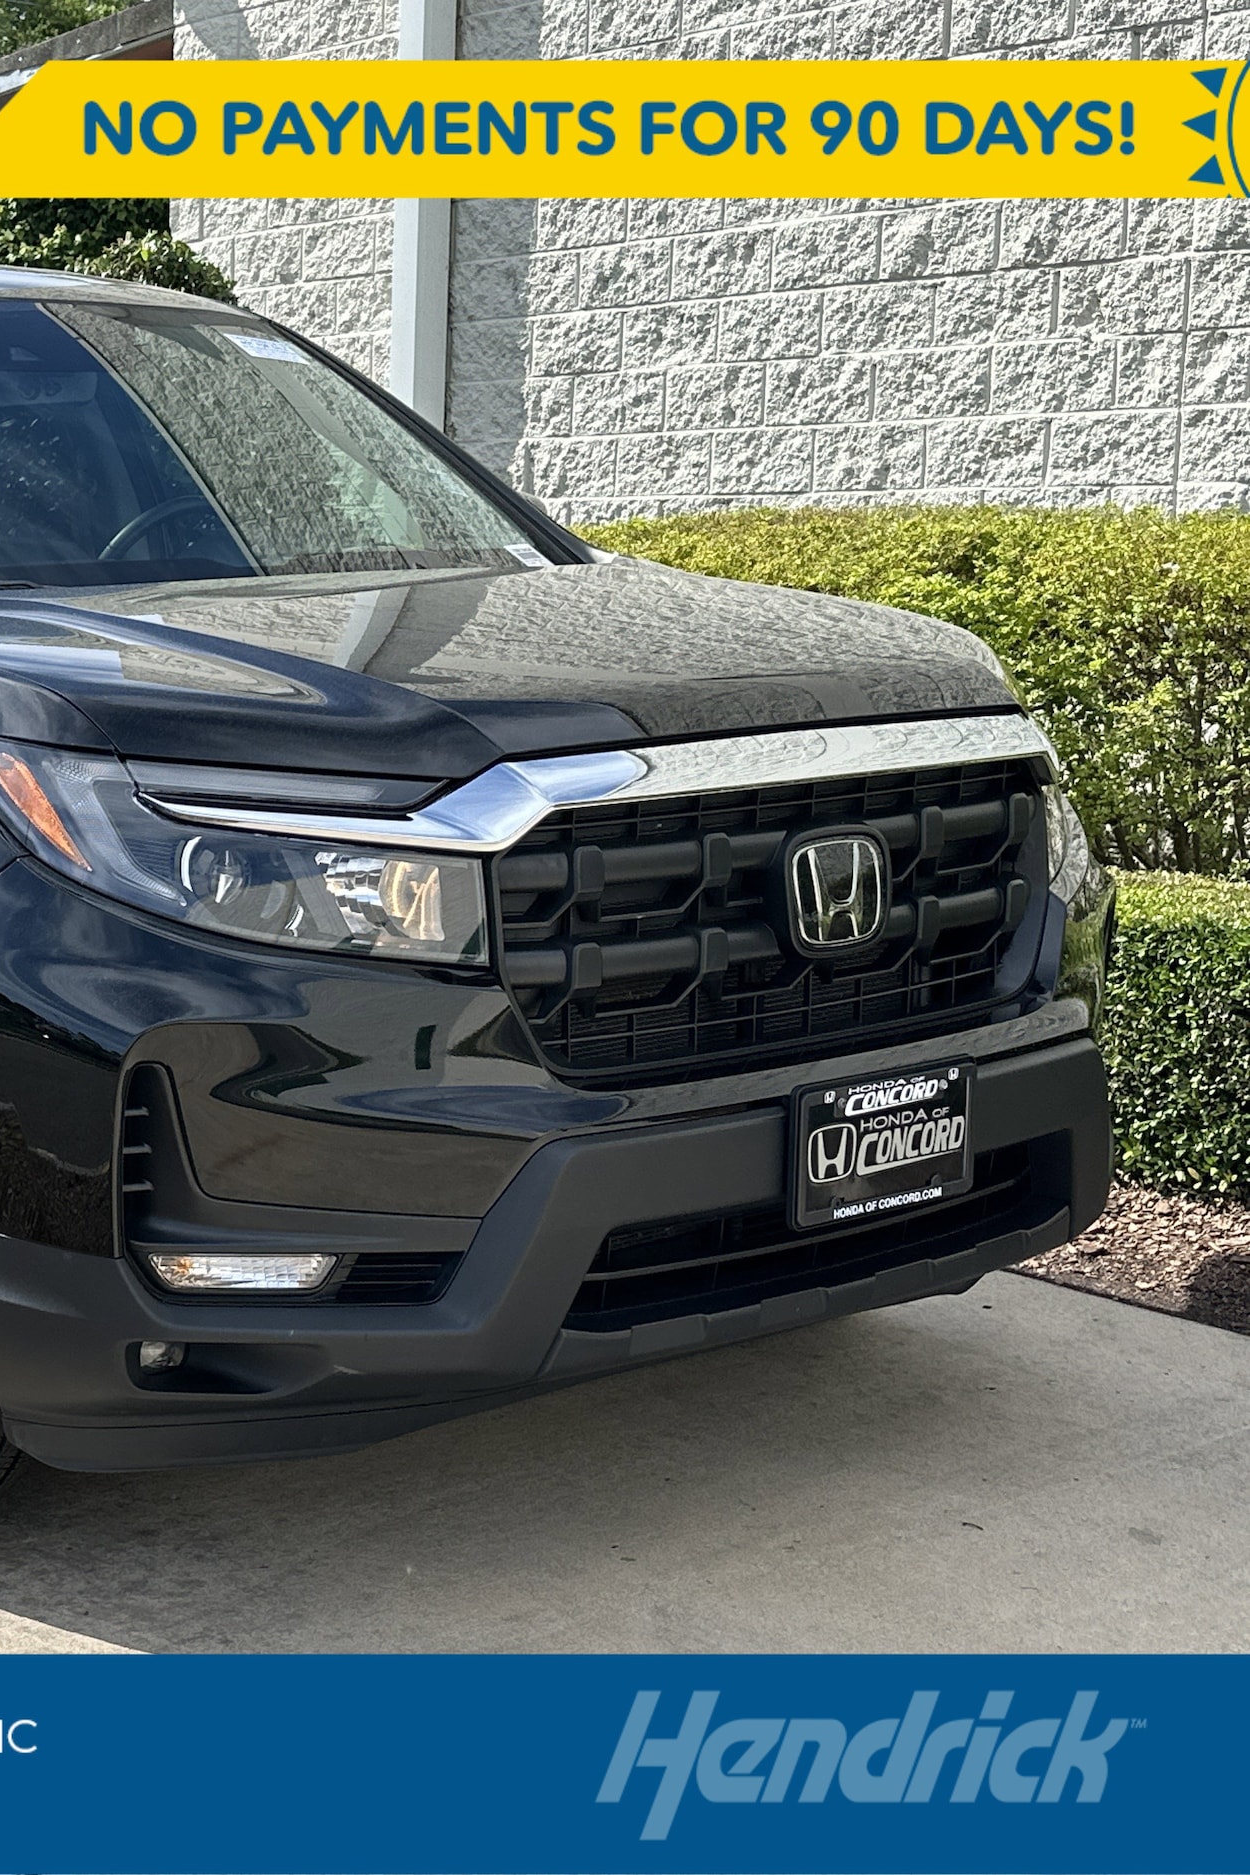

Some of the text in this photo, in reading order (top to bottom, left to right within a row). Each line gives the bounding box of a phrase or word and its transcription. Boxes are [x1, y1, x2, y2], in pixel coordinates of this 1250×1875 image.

[845, 1079, 938, 1116] CONCORD
[848, 1075, 925, 1095] HONDA OF
[860, 1107, 949, 1132] HONDA OF
[856, 1115, 965, 1176] CONCORD
[833, 1186, 942, 1219] HONDA OF CONCORD.COM
